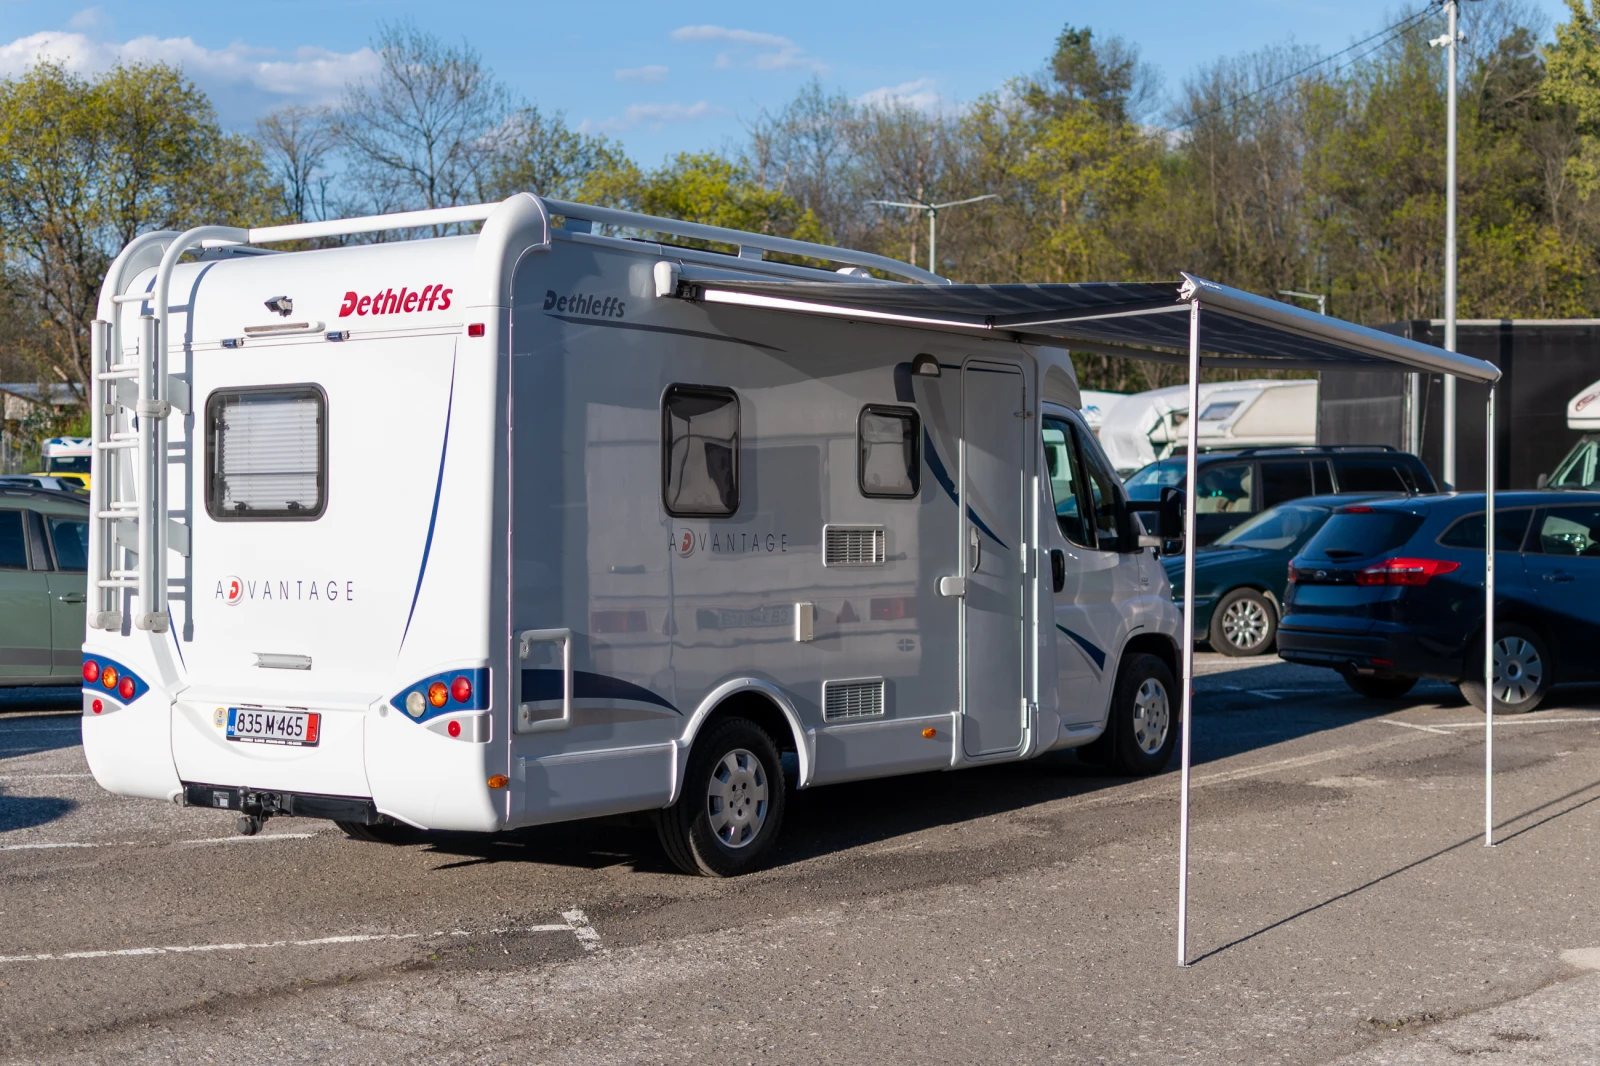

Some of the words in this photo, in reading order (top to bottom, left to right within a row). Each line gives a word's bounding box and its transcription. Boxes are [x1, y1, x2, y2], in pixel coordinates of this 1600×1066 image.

[338, 283, 454, 318] Dethleffs
[542, 289, 626, 319] Dethleffs
[667, 530, 788, 556] ADVANTAGE
[214, 577, 354, 604] ADVANTAGE
[236, 712, 263, 734] 835
[265, 714, 276, 735] M
[277, 715, 303, 737] 465
